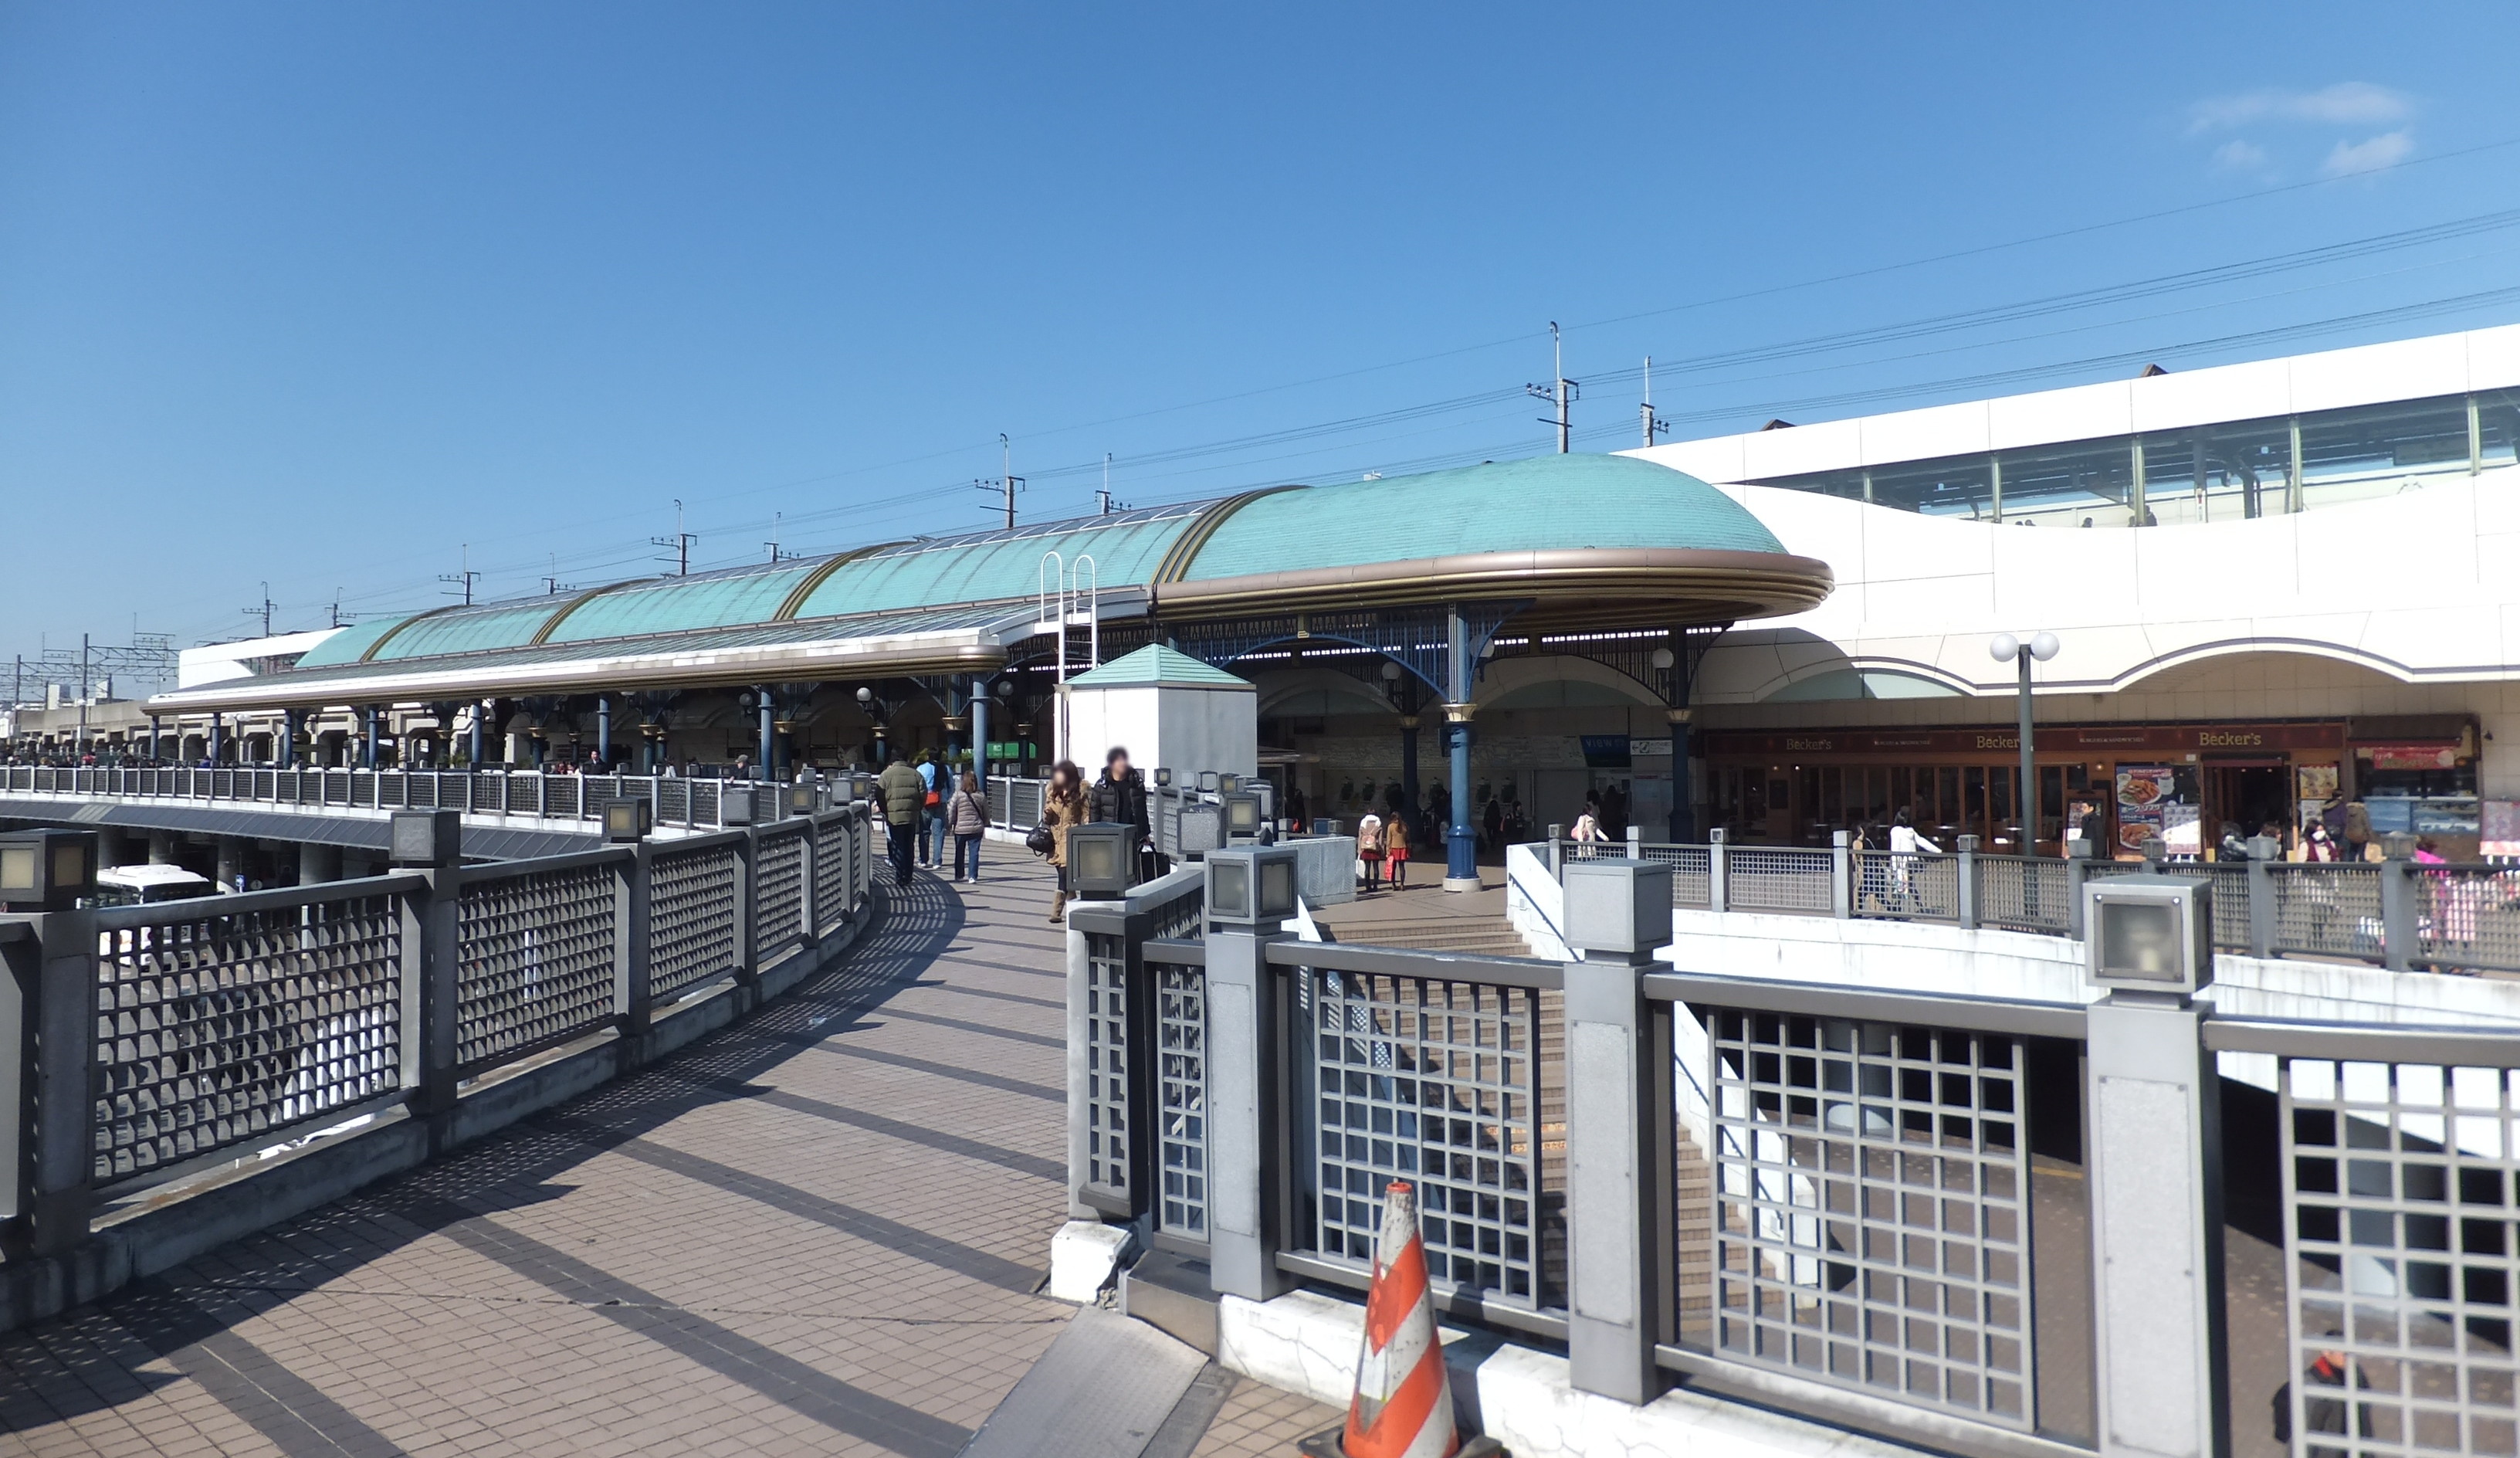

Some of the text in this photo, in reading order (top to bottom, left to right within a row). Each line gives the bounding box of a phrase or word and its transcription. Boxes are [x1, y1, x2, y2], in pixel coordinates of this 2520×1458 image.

[1586, 738, 1613, 748] VIEW
[1786, 738, 1832, 750] Becker's
[1976, 735, 2020, 748] Becker
[2198, 732, 2262, 746] Becker's
